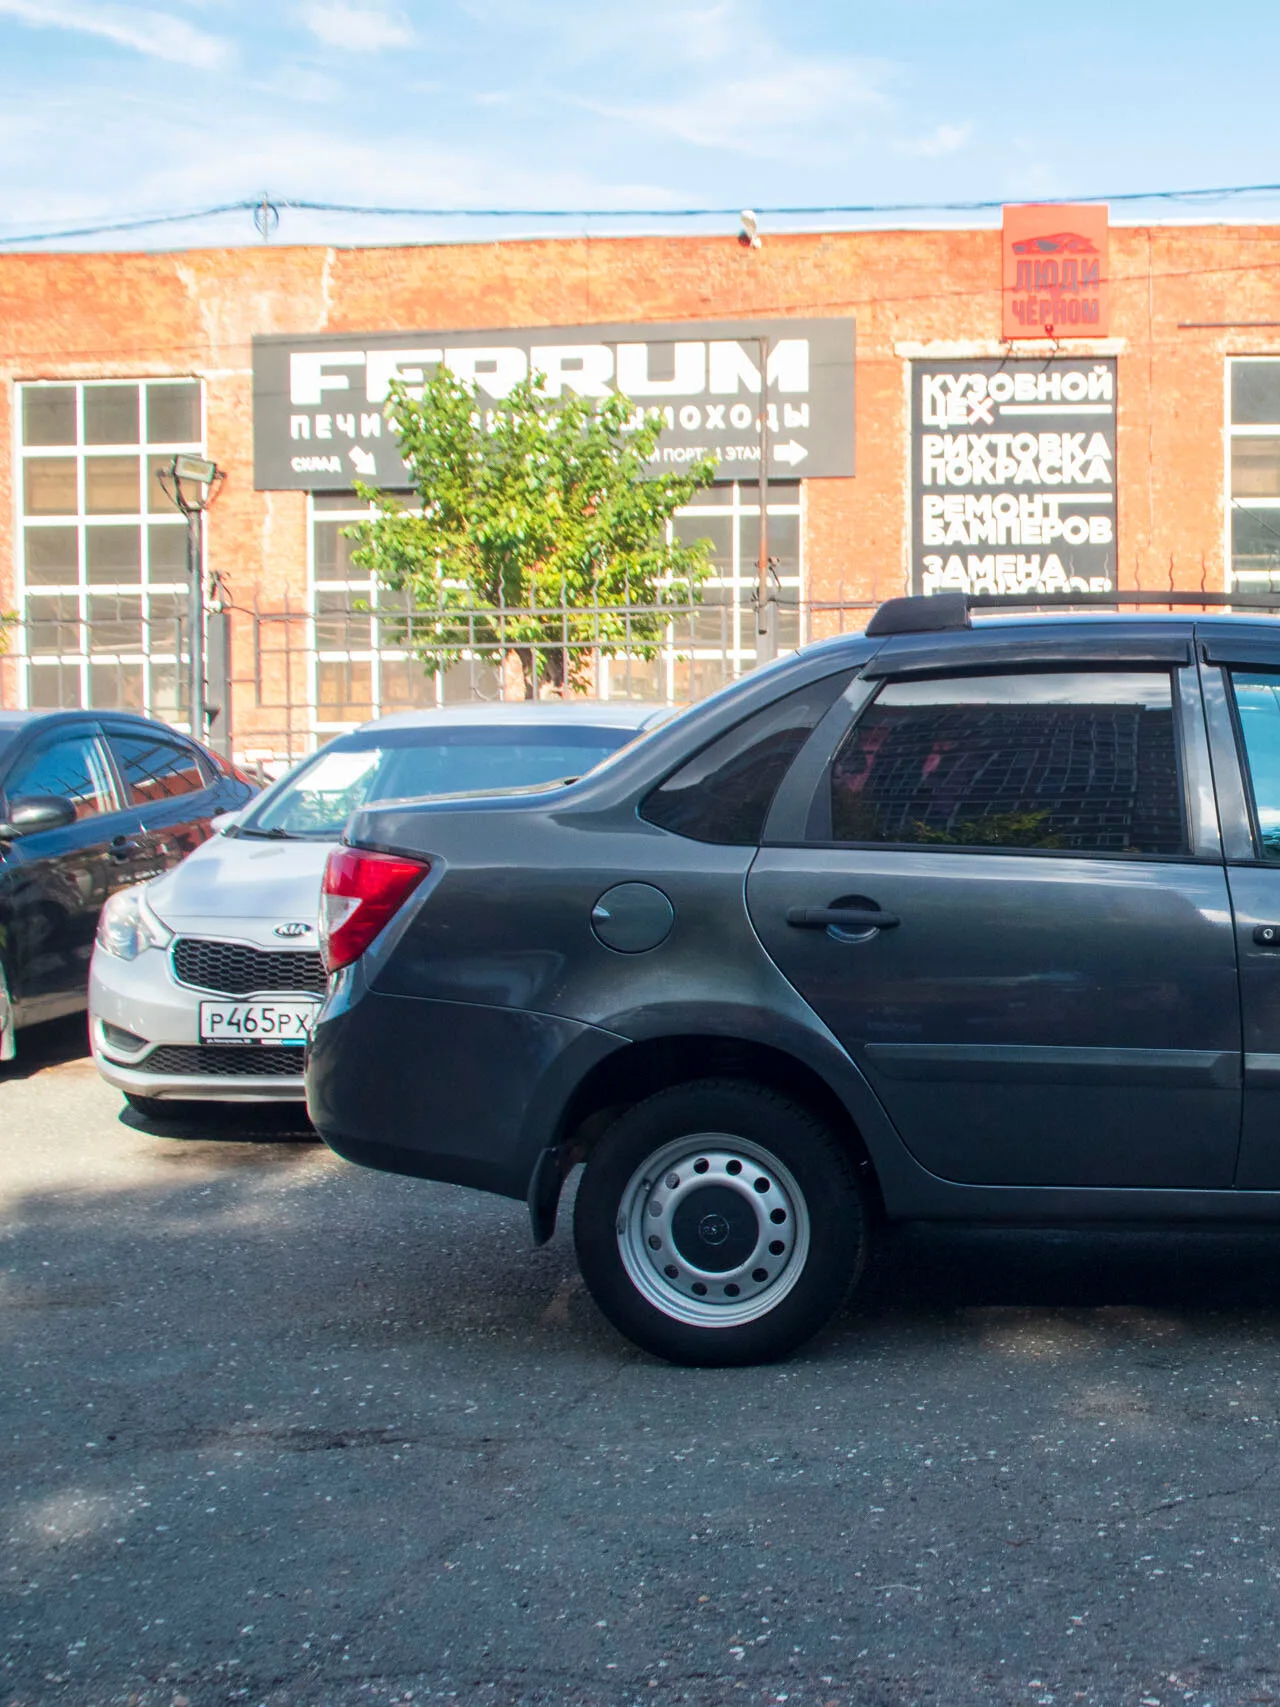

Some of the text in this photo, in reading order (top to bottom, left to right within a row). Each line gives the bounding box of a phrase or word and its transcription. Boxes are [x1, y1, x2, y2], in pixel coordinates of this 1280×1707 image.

[1014, 259, 1099, 293] ЛЮДИ
[290, 339, 809, 406] FERRUM
[922, 366, 1112, 402] КУЗОВНОЙ
[922, 393, 995, 429] ЦЕХ
[290, 414, 381, 440] ПЕЧИ
[922, 432, 1112, 462] РИХТОВКА
[922, 455, 1112, 486] ПОКРАСКА
[922, 493, 1066, 522] РЕМОНТ
[922, 515, 1113, 545] БАМПЕРОВ
[922, 553, 1068, 582] ЗАМЕНА
[277, 924, 309, 937] KIA
[211, 1007, 308, 1033] Р465РХ
